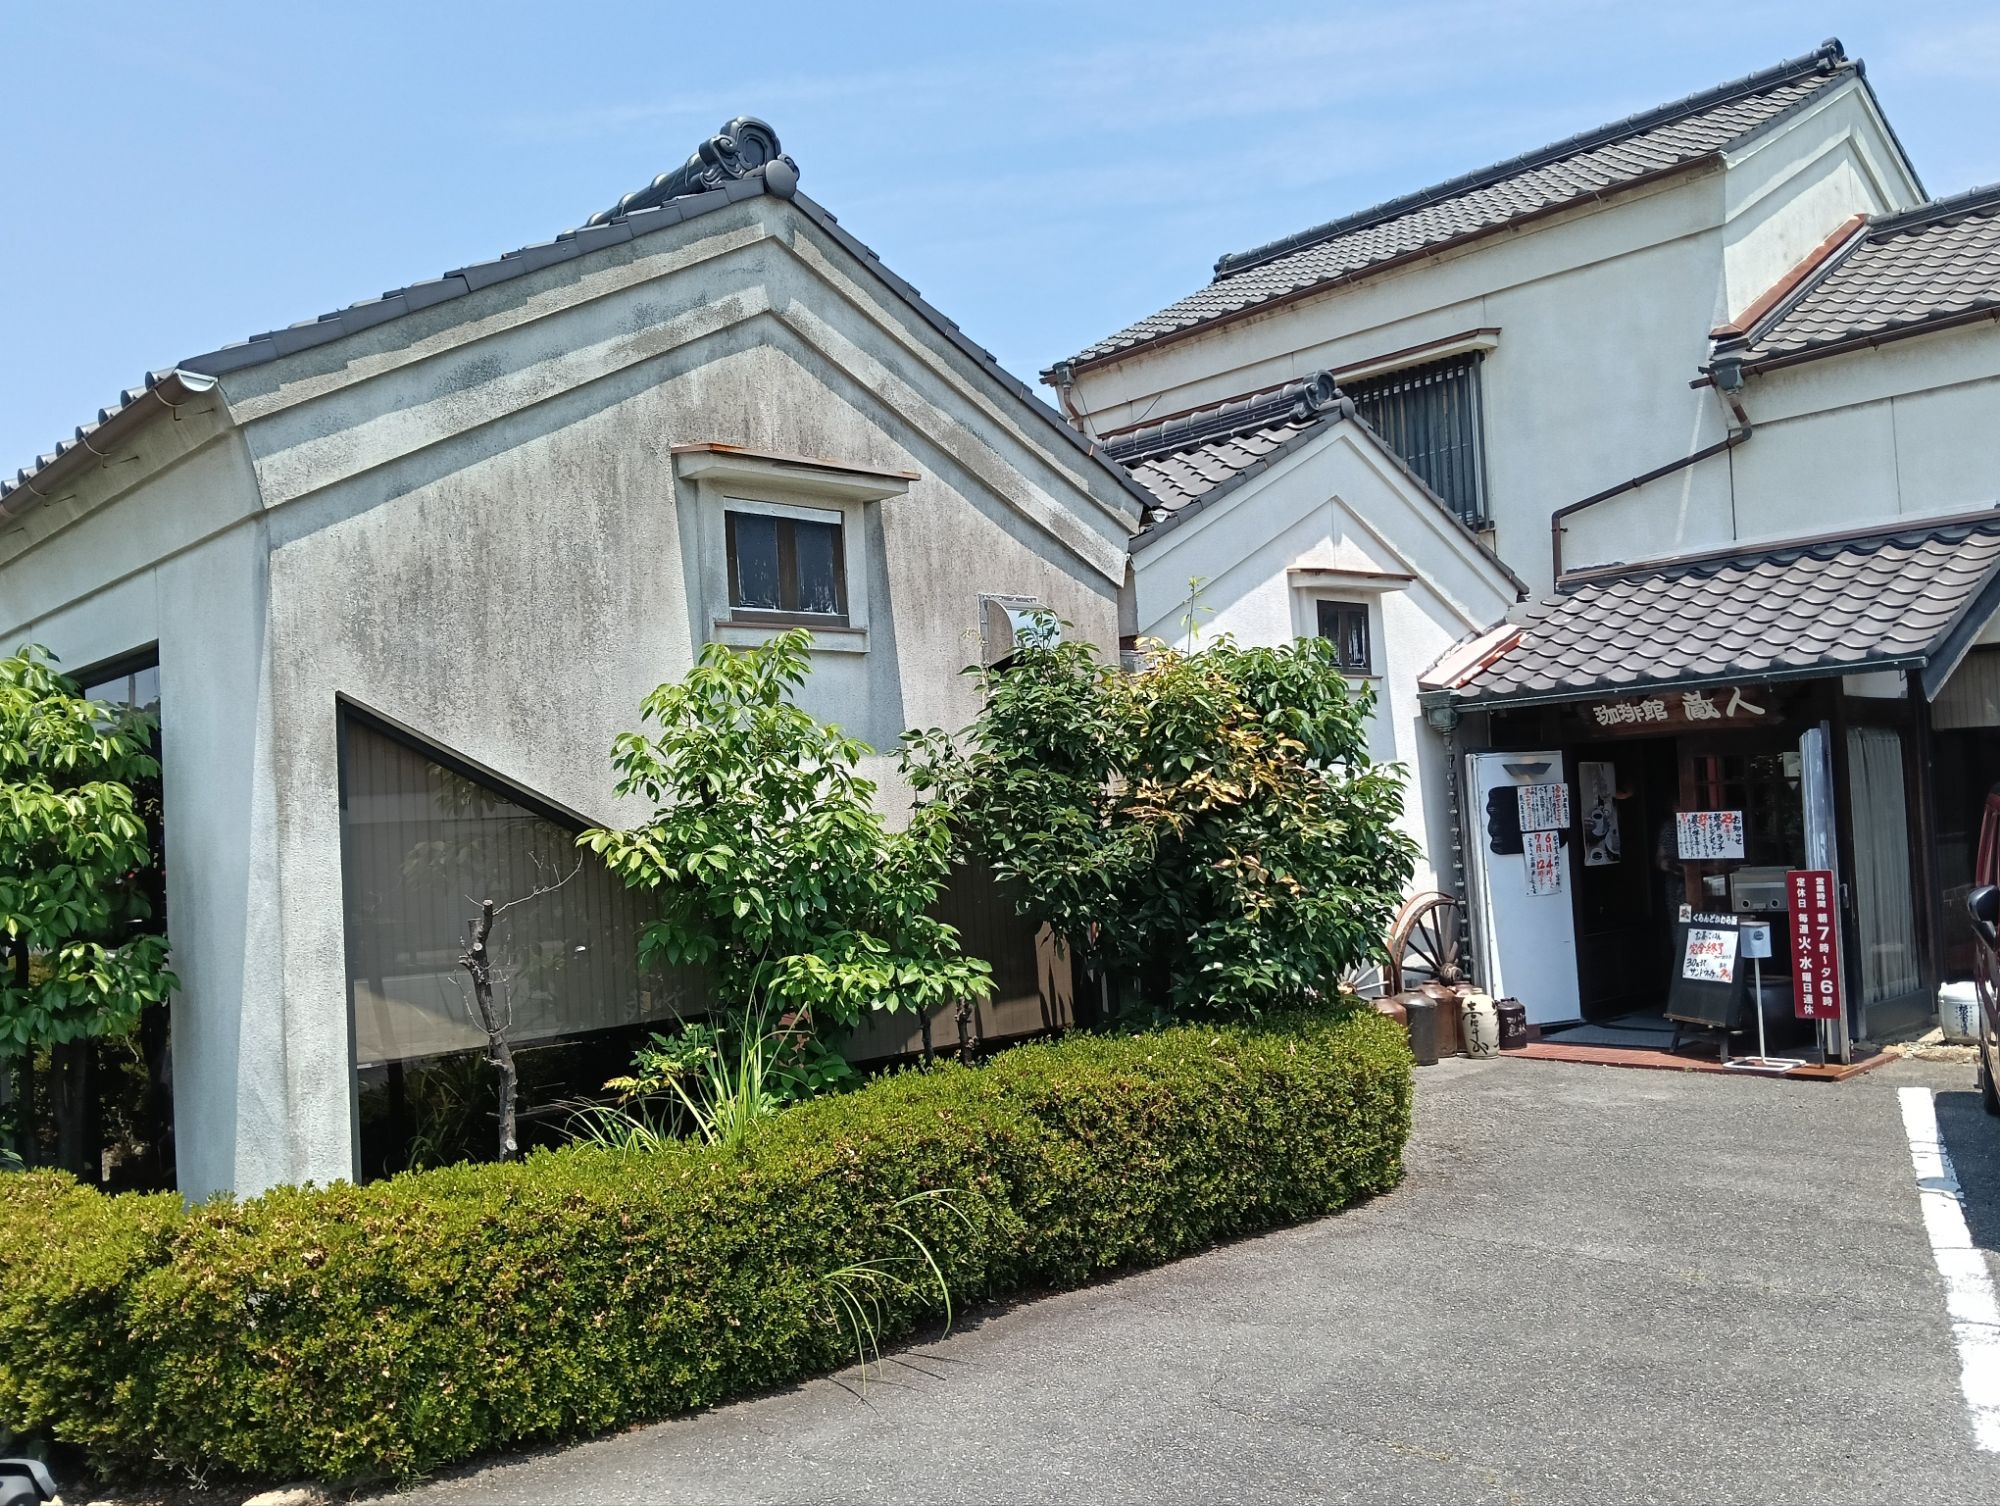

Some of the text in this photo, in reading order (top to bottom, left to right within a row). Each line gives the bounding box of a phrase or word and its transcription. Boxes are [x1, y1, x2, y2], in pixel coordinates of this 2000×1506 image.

[1593, 686, 1766, 726] 珈琲館 蔵人
[1796, 877, 1807, 909] 定休日
[1815, 877, 1827, 908] 営業時間
[1688, 942, 1725, 956] 完全終了
